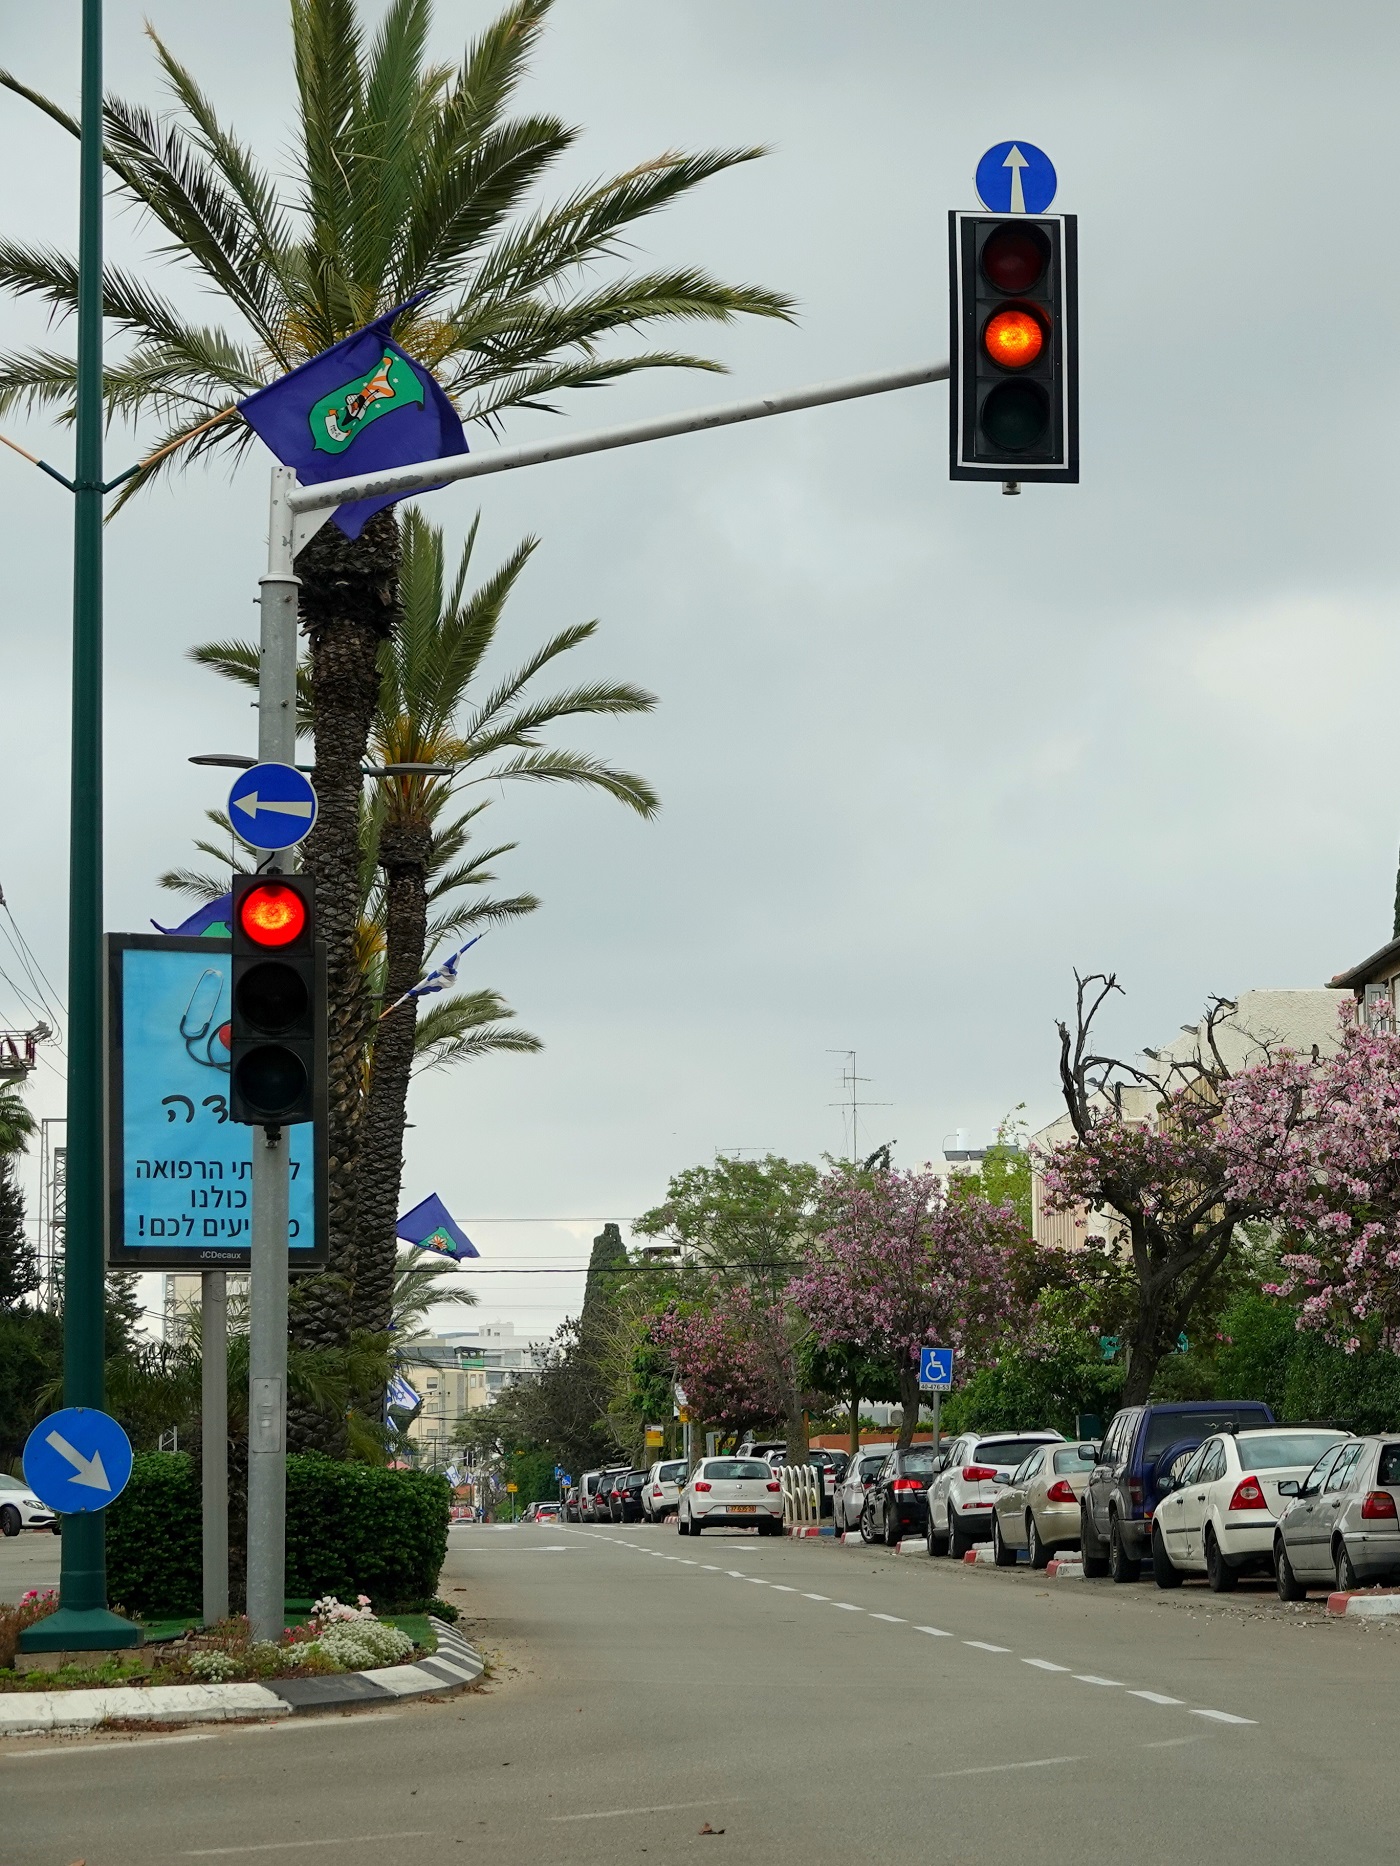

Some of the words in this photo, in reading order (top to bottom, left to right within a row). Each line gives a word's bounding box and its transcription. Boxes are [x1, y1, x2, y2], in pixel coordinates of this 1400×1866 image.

[137, 1160, 223, 1179] הרפואה
[191, 1186, 247, 1208] כולנו
[139, 1214, 195, 1236] לכם!
[199, 1250, 242, 1260] JCDecaux
